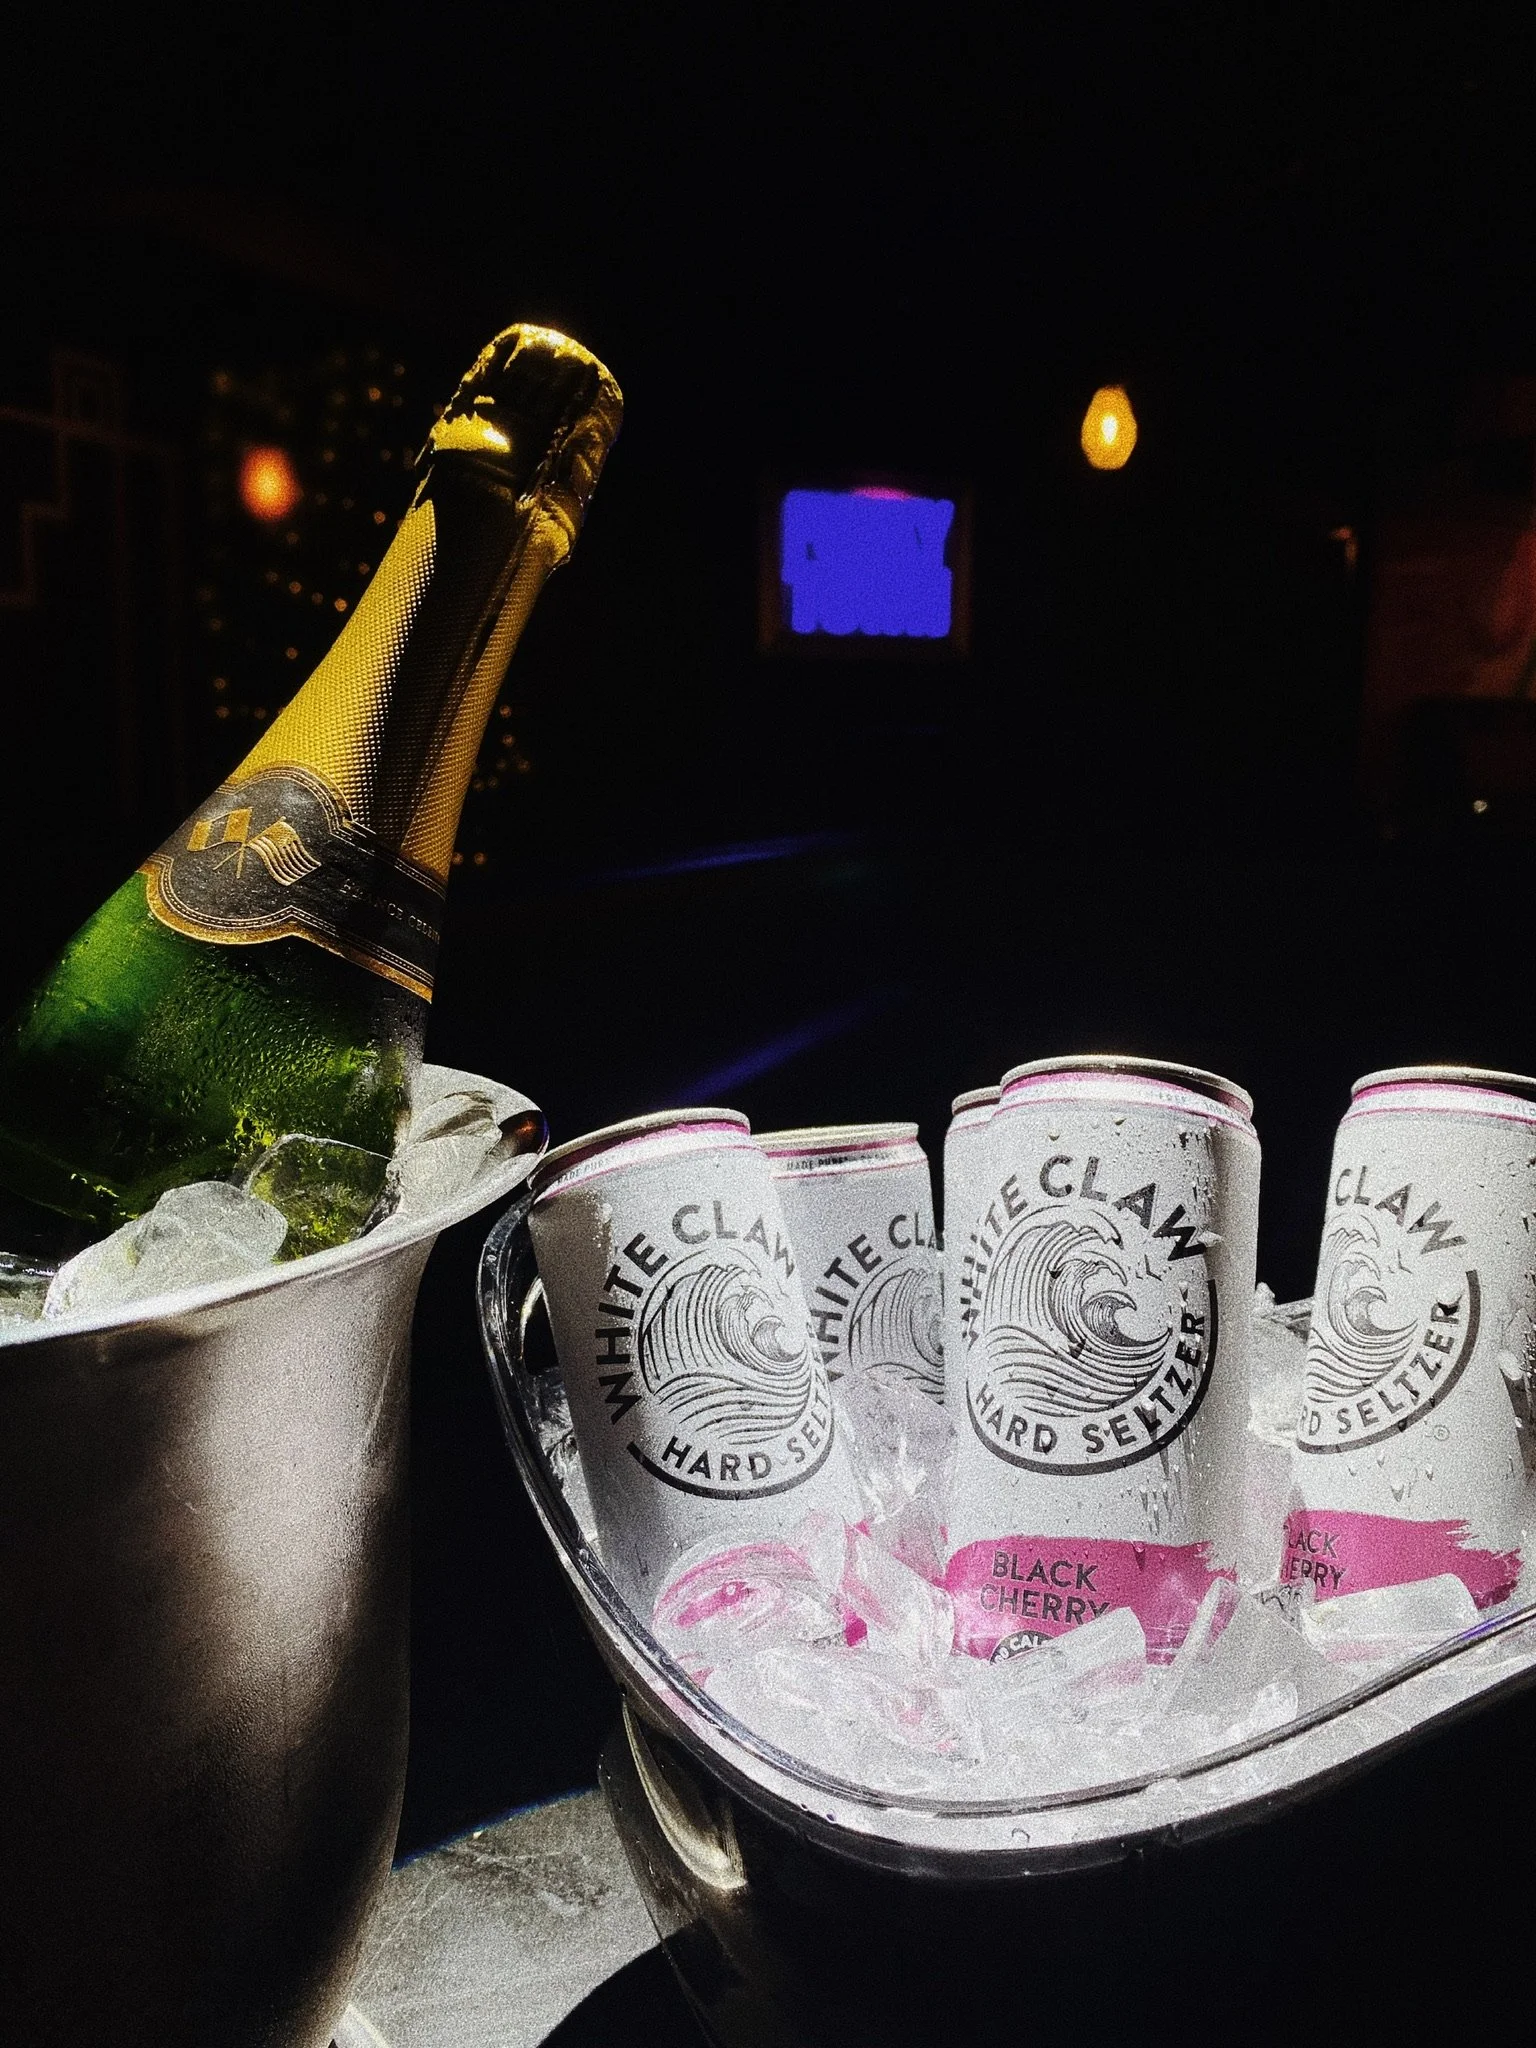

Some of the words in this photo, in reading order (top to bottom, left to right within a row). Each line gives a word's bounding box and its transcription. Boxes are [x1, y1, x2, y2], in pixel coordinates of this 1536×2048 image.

[959, 1174, 1029, 1352] WHITE
[1039, 1155, 1207, 1261] CLAW
[1334, 1165, 1467, 1255] CLAW
[595, 1232, 670, 1425] WHITE
[671, 1200, 796, 1279] CLAW
[1337, 1294, 1464, 1435] SELTZER
[975, 1382, 1058, 1455] HARD
[1081, 1311, 1206, 1455] SELTZER
[661, 1435, 771, 1481] HARD
[980, 1583, 1110, 1626] CHERRY
[992, 1551, 1099, 1592] BLACK
